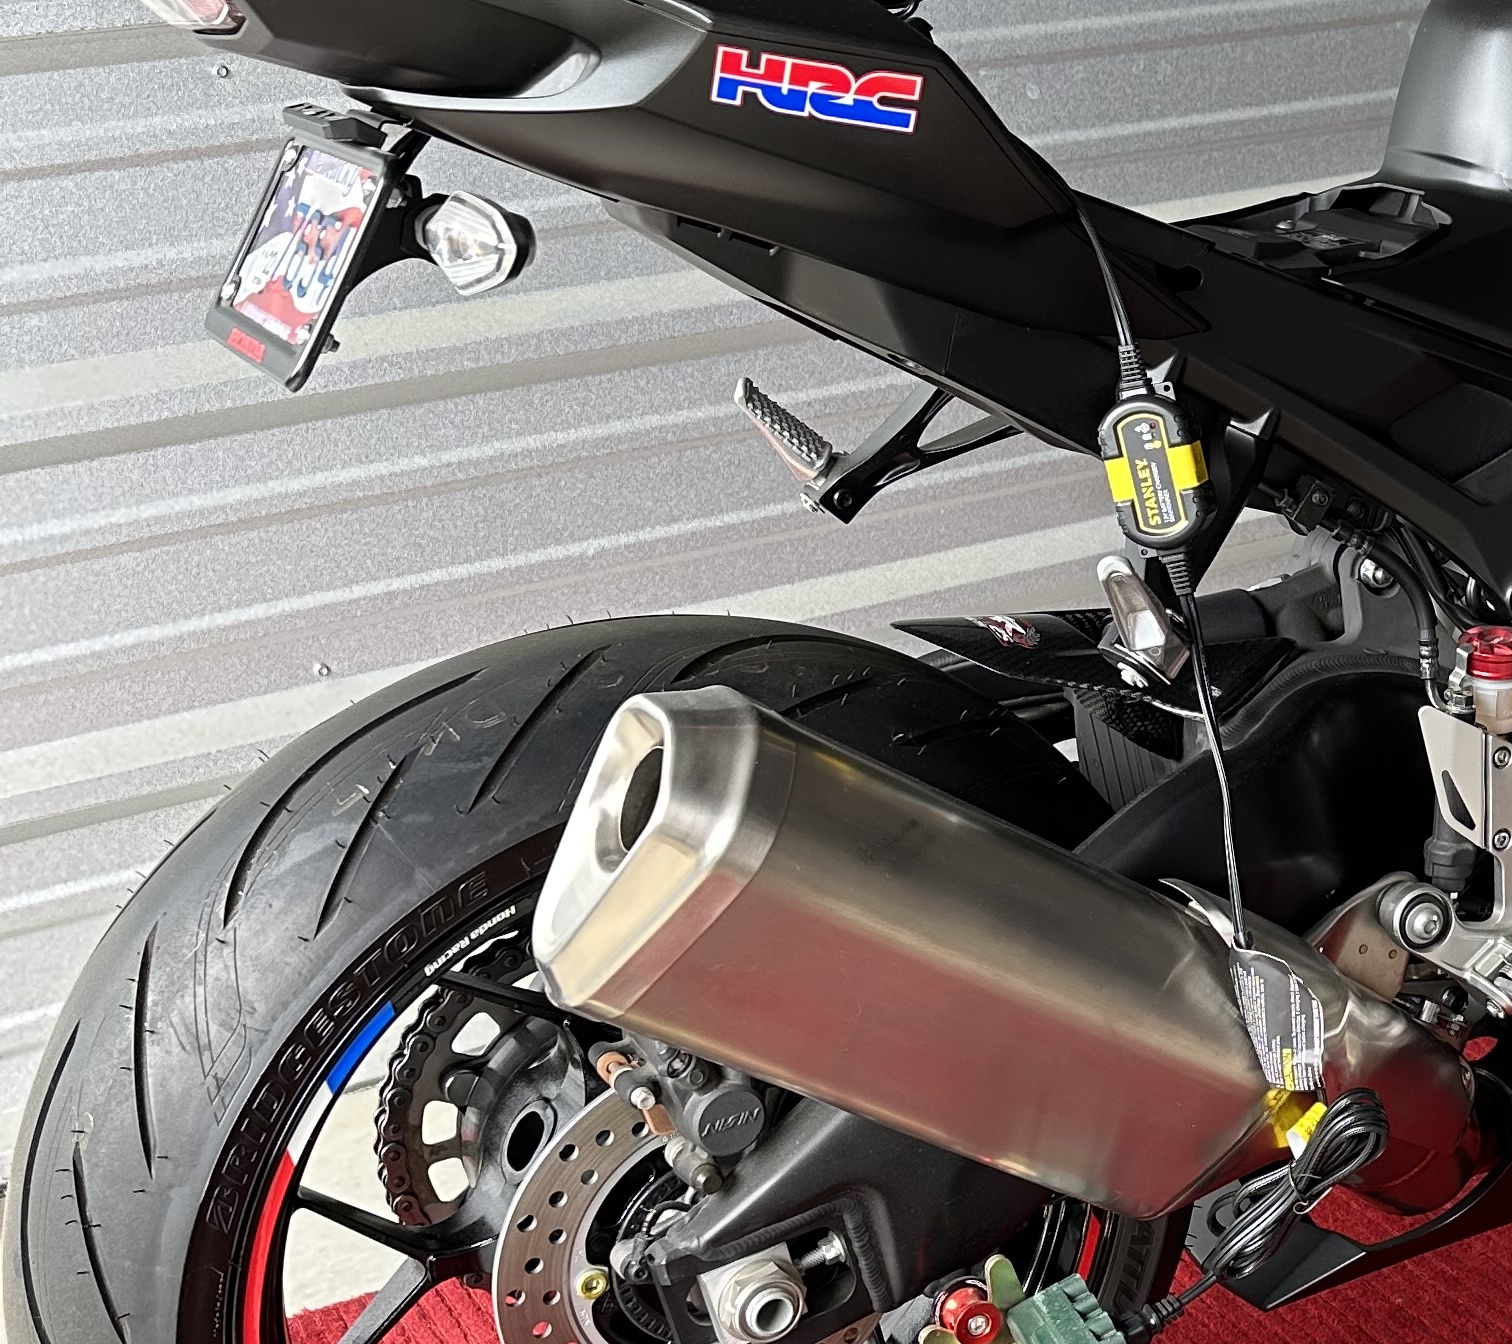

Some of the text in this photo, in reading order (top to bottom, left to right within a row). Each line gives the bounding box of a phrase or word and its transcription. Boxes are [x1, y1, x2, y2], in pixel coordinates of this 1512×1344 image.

[710, 44, 923, 134] HRC
[1135, 458, 1161, 526] STANLEY
[424, 905, 516, 976] Honda Racing
[206, 871, 490, 1234] BRIDGESTONE
